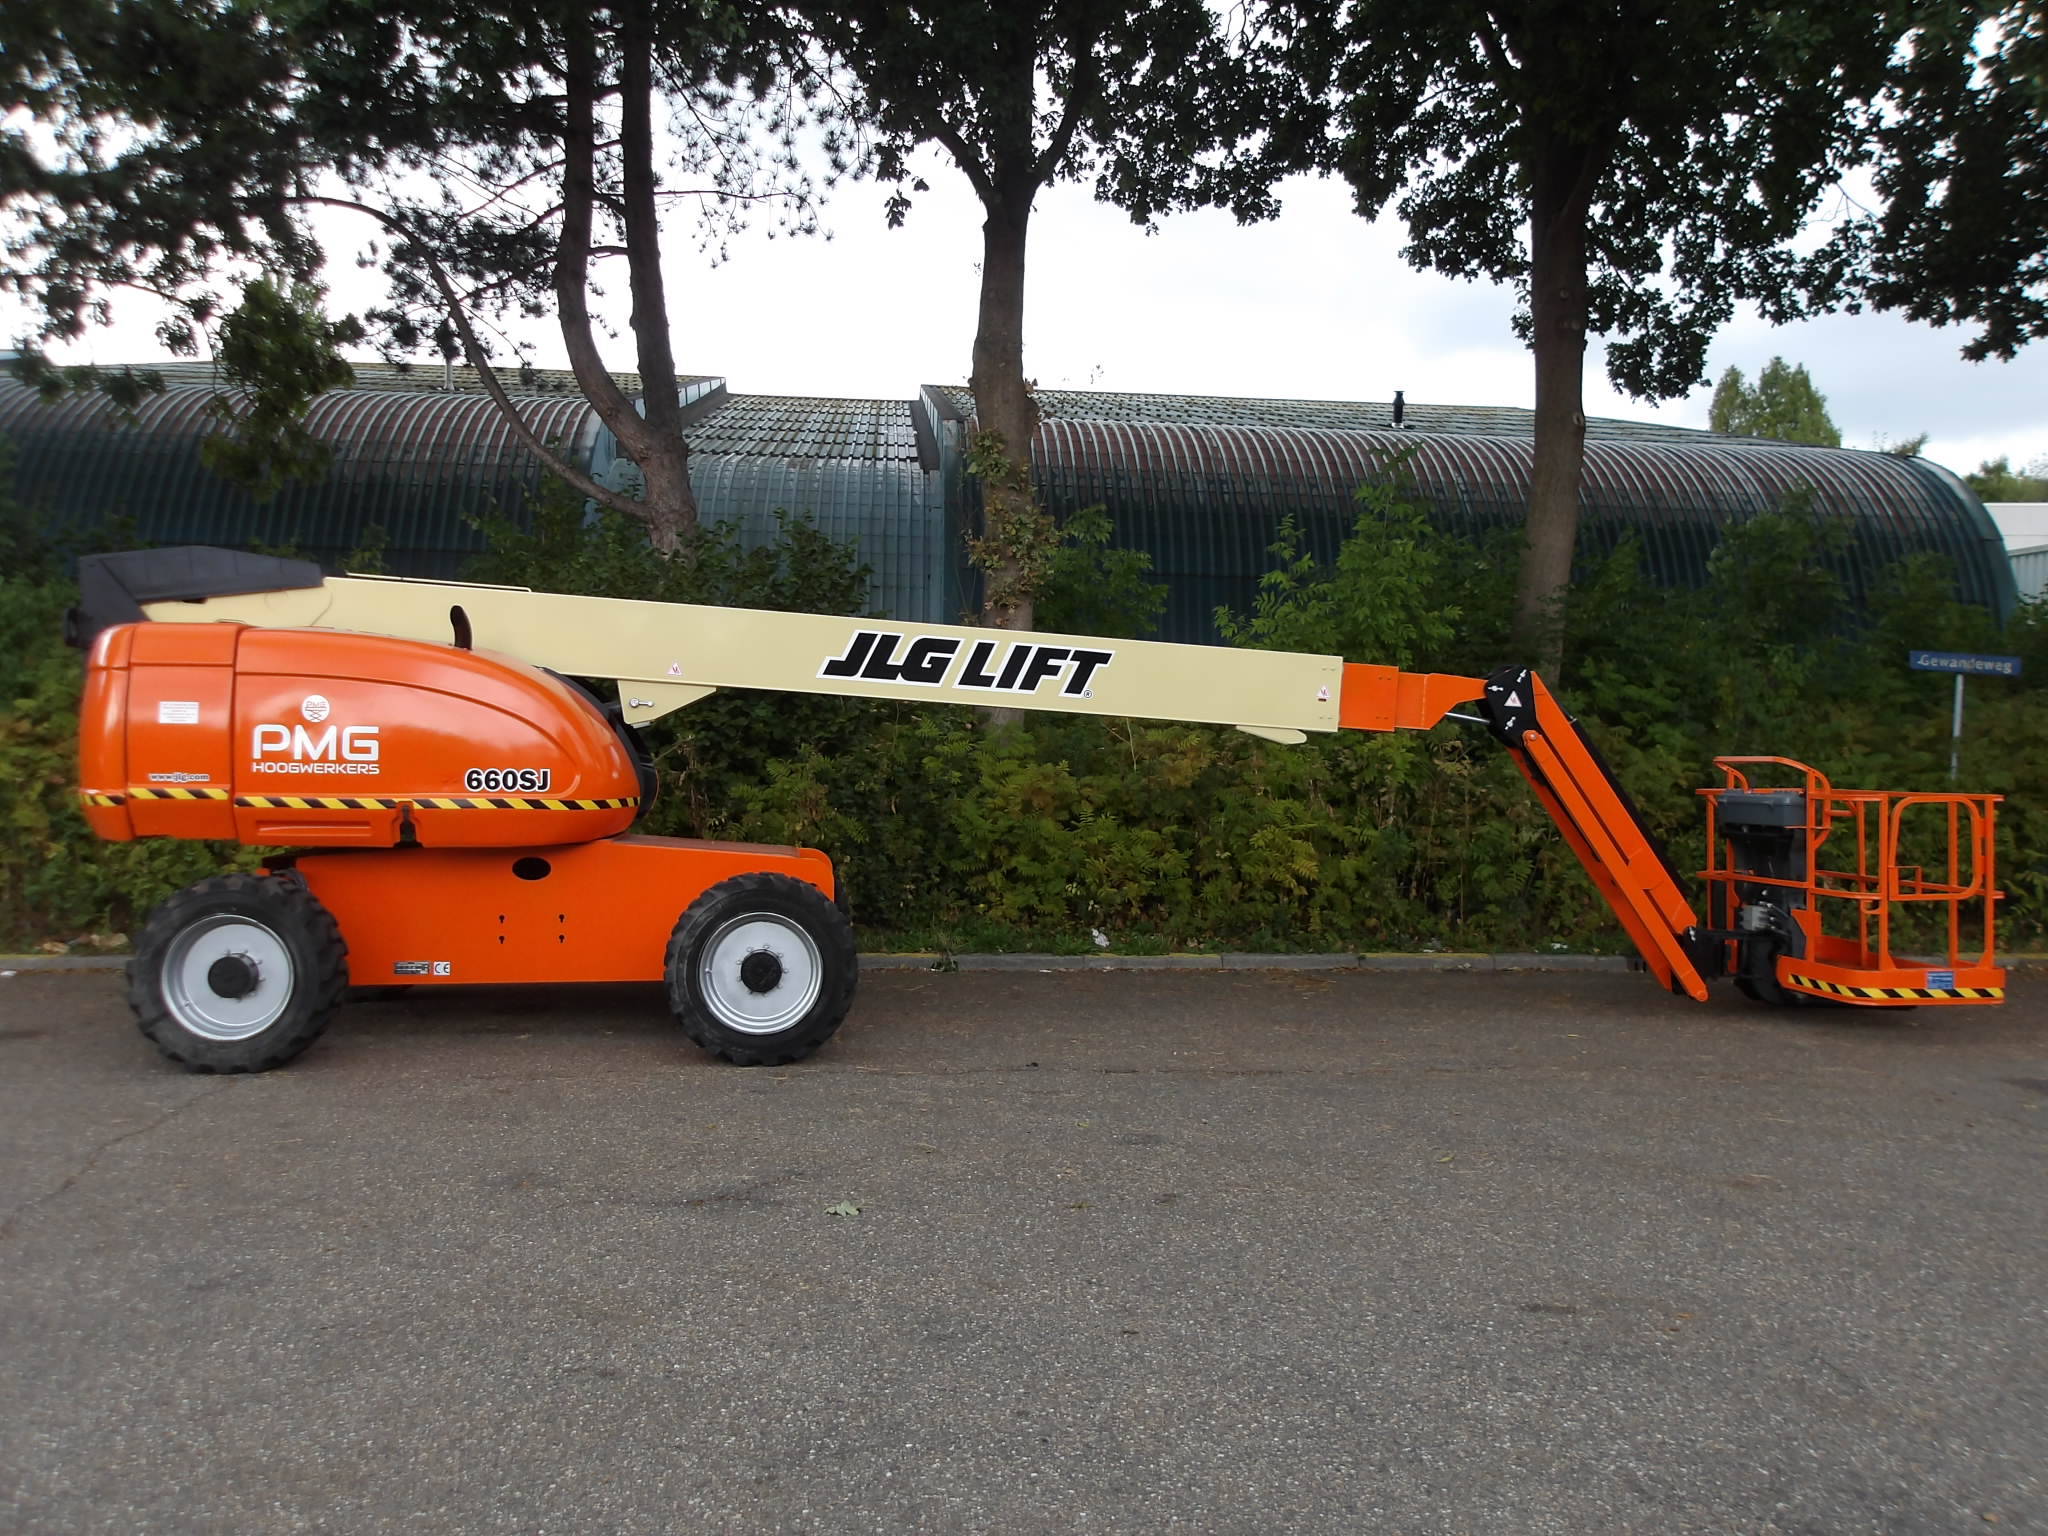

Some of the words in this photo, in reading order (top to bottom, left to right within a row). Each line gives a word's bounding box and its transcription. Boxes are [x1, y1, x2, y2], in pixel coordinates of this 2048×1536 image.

[821, 631, 963, 686] JLG
[957, 641, 1114, 696] LIFT
[252, 724, 380, 761] PMG
[252, 761, 380, 775] HOOGWERKERS
[465, 768, 551, 792] 660SJ
